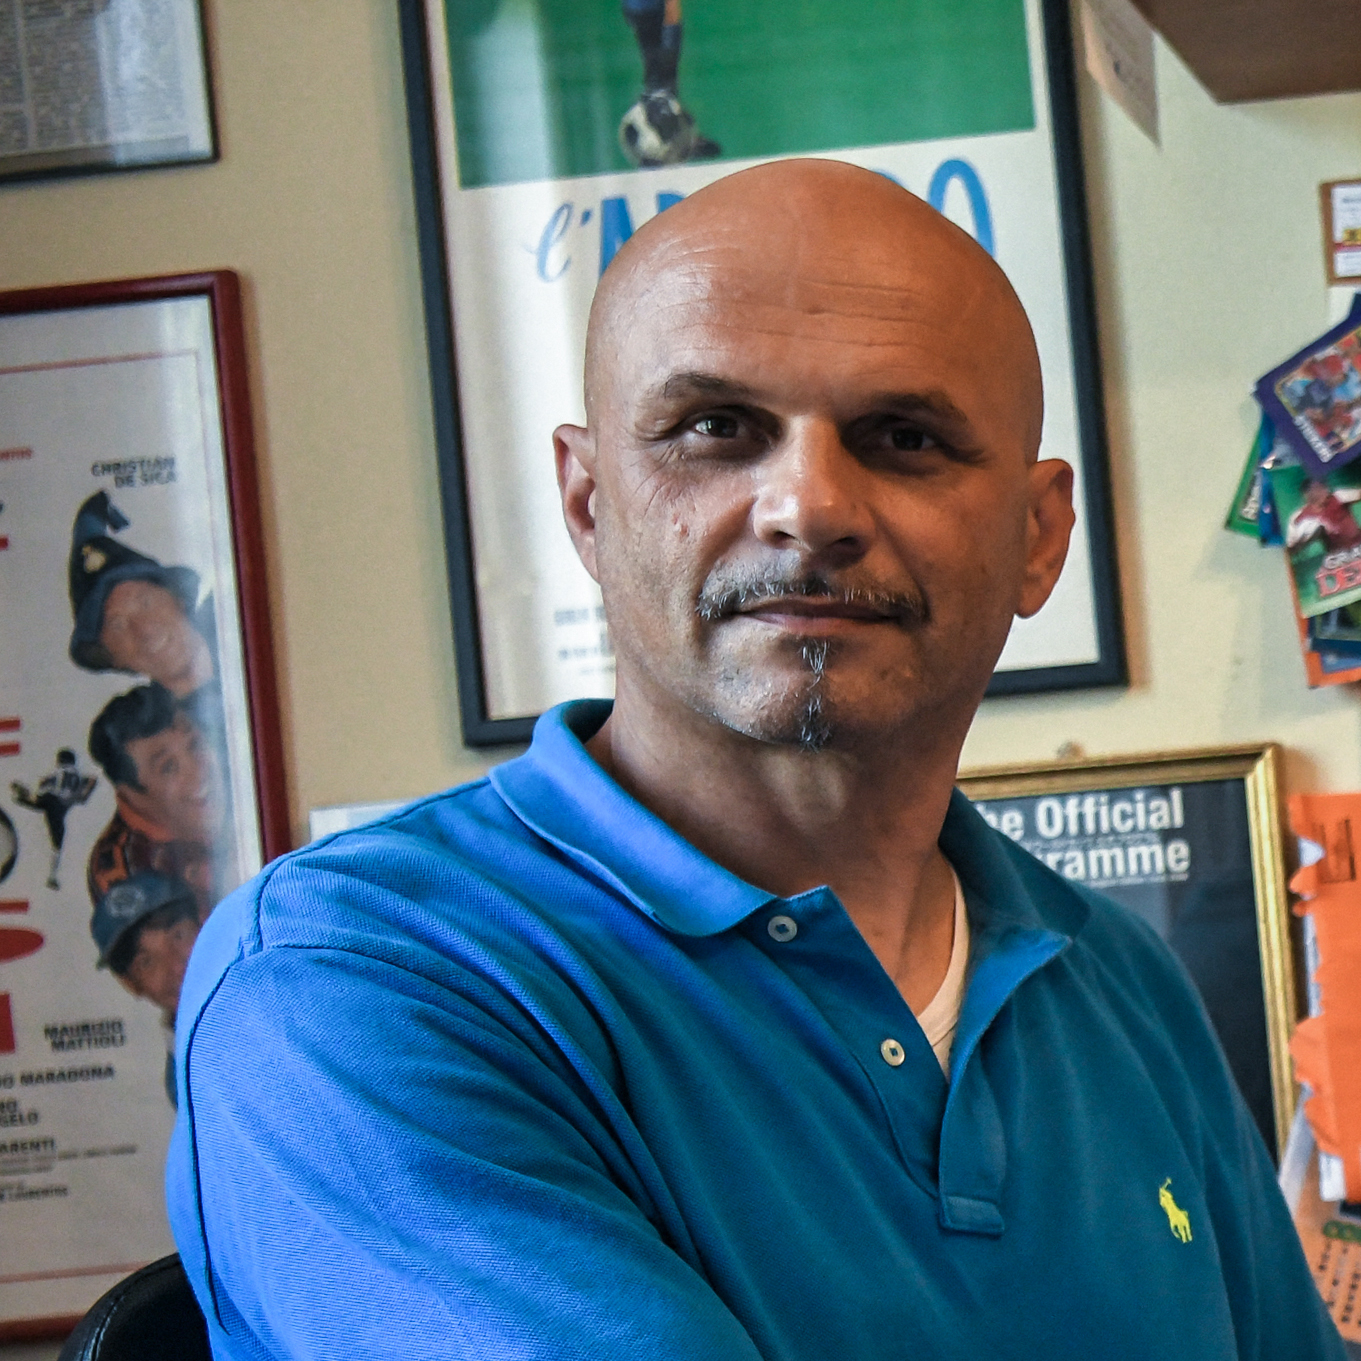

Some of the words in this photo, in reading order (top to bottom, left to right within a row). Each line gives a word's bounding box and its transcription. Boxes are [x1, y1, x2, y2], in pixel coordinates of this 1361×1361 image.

[975, 802, 1025, 841] he
[1035, 786, 1185, 840] Official
[1040, 838, 1191, 880] ramme
[44, 1018, 125, 1039] MAURIZIO
[51, 1035, 125, 1051] MATTIOLI
[20, 1064, 115, 1086] MARADONA
